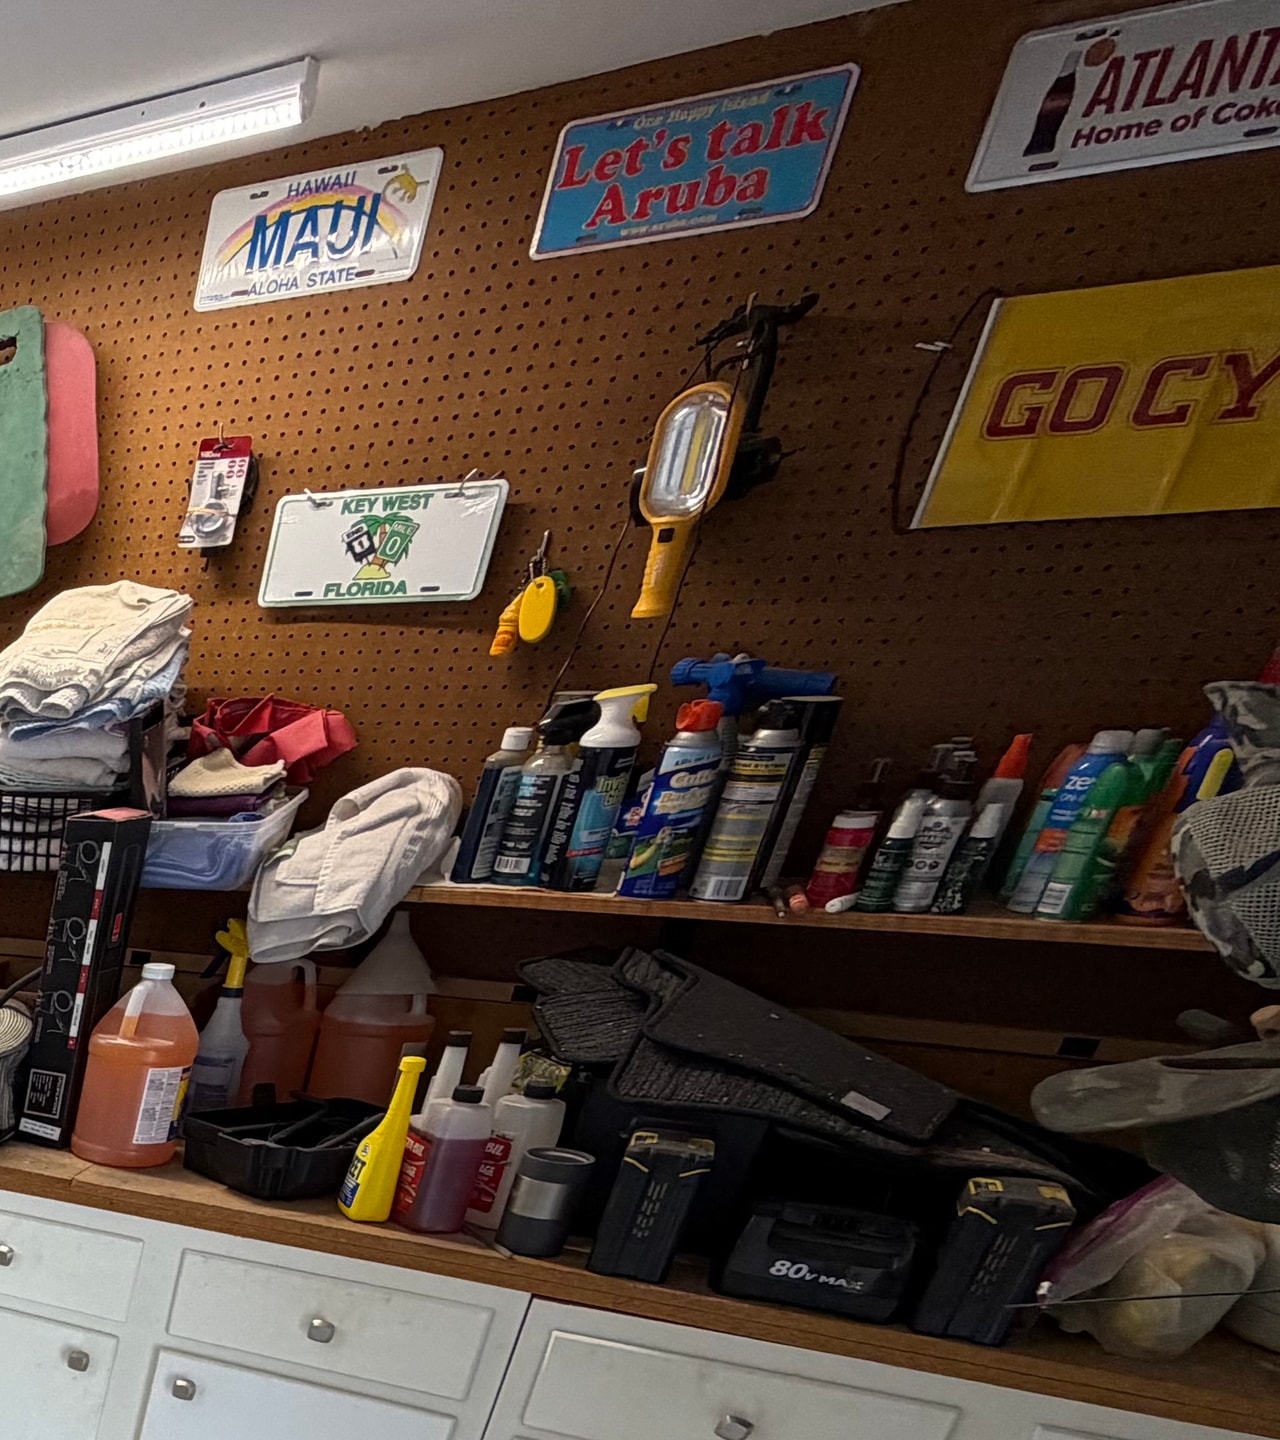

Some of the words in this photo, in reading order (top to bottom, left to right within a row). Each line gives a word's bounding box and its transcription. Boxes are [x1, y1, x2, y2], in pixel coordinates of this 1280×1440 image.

[1081, 26, 1280, 118] ATLANT
[666, 103, 717, 124] Happy
[1070, 118, 1163, 149] Home
[1170, 105, 1208, 132] of
[555, 129, 692, 190] Let's
[705, 101, 830, 162] talk
[287, 171, 357, 199] HAWAII
[582, 164, 769, 230] Aruba
[245, 193, 382, 271] MAUI
[248, 275, 299, 297] ALOHA
[306, 266, 357, 288] STATE
[981, 364, 1129, 440] GO
[1129, 350, 1280, 430] CY
[340, 497, 380, 515] KEY
[381, 493, 435, 512] WEST
[385, 536, 401, 555] 0
[323, 580, 408, 597] FLORIDA
